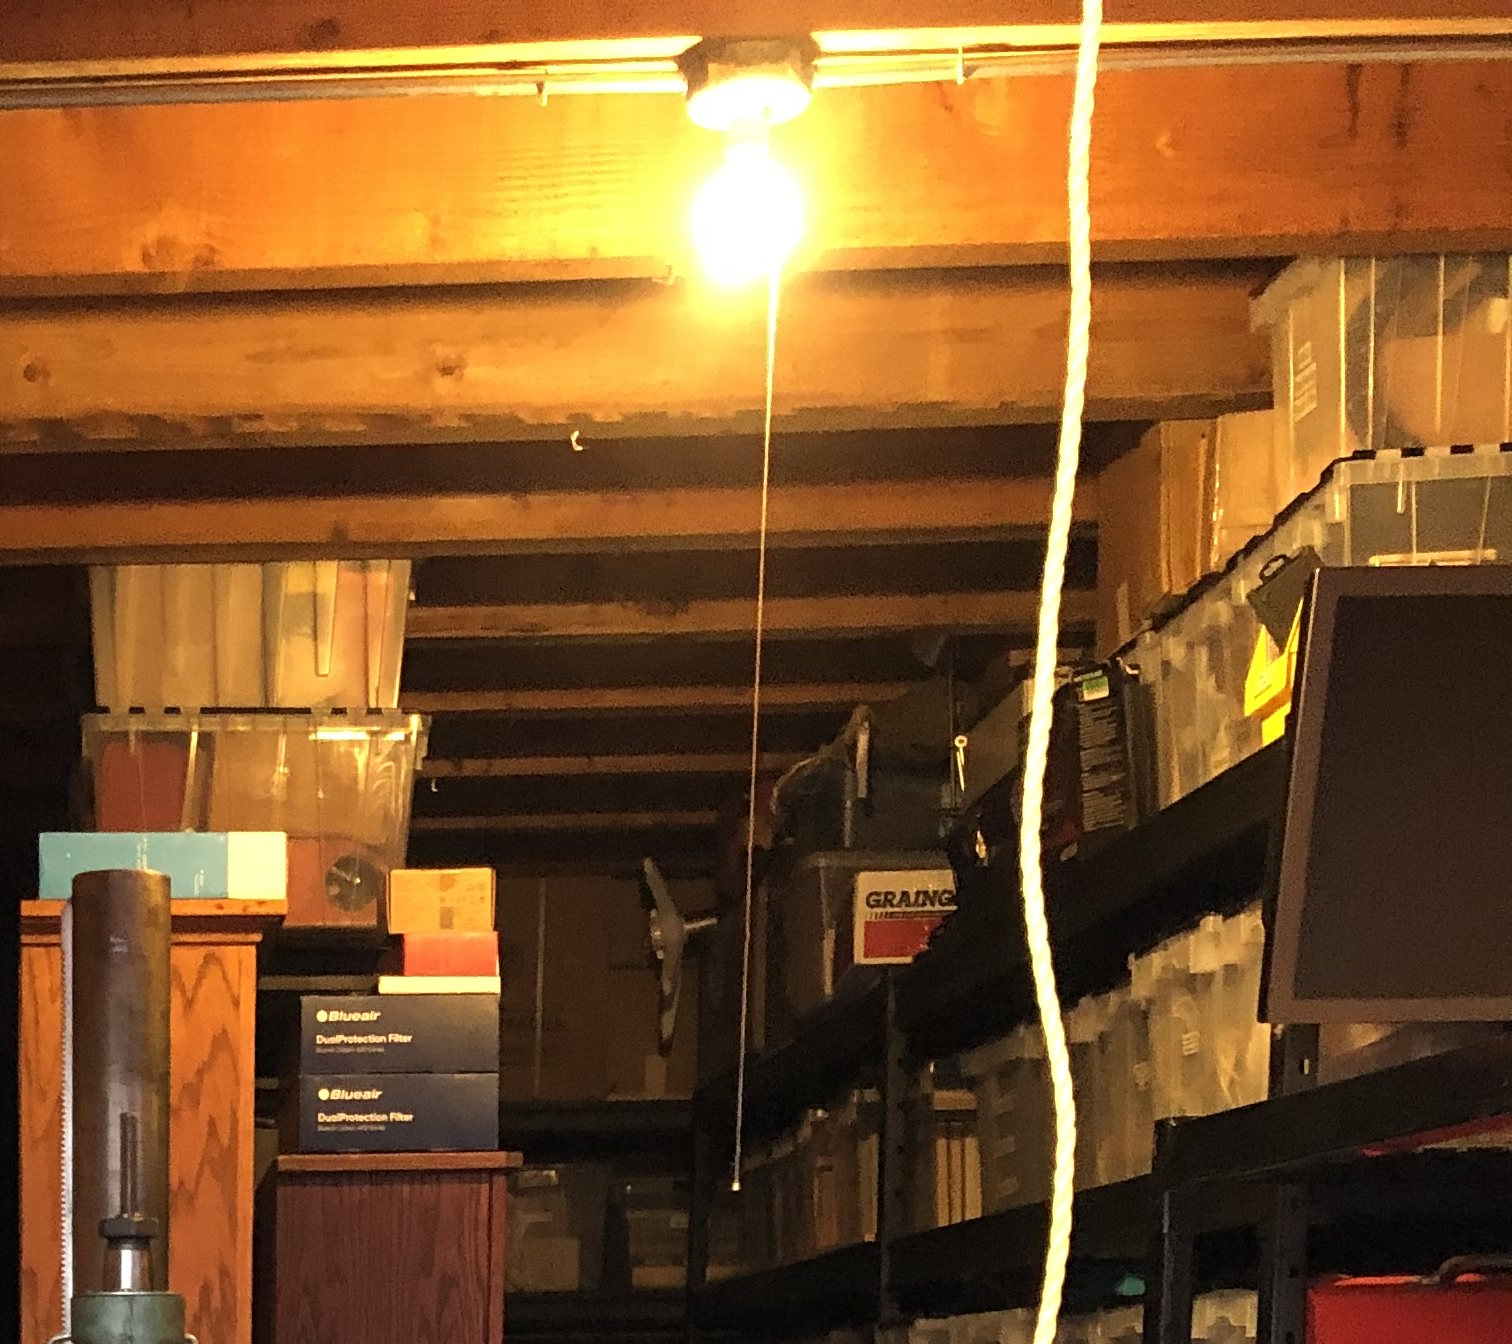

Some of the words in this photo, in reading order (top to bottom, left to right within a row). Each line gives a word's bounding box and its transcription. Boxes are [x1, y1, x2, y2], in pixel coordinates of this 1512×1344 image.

[329, 1010, 381, 1022] Blueair
[316, 1034, 386, 1045] DualProtection
[388, 1033, 412, 1043] Filter
[330, 1088, 382, 1100] Blueair
[318, 1112, 388, 1123] DualProtection
[390, 1112, 414, 1122] Filter
